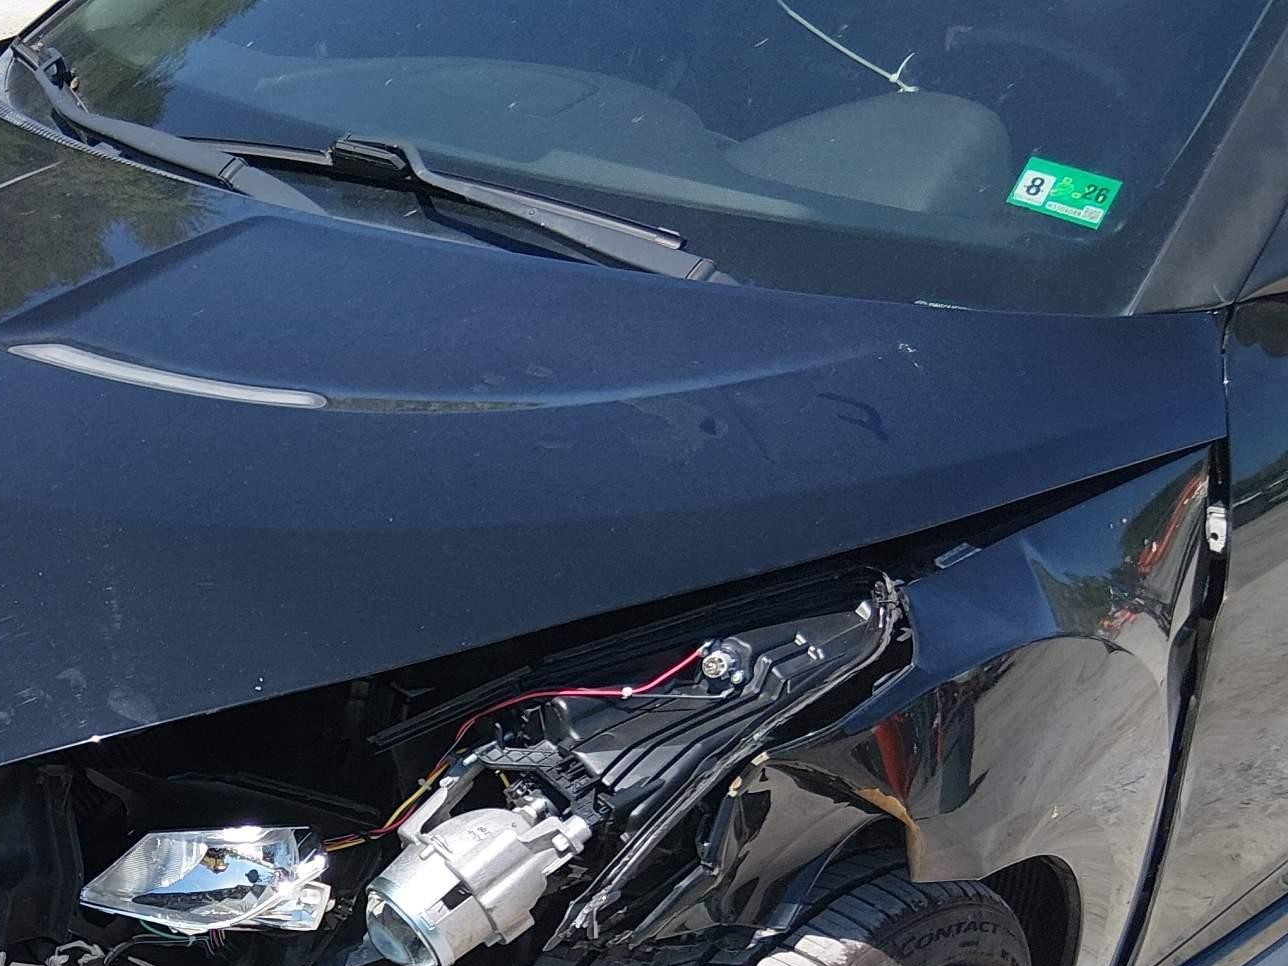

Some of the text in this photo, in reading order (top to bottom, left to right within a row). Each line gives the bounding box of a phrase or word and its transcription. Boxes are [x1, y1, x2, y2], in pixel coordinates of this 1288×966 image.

[1025, 176, 1110, 204] 8 26
[902, 920, 1000, 957] CONTACT
